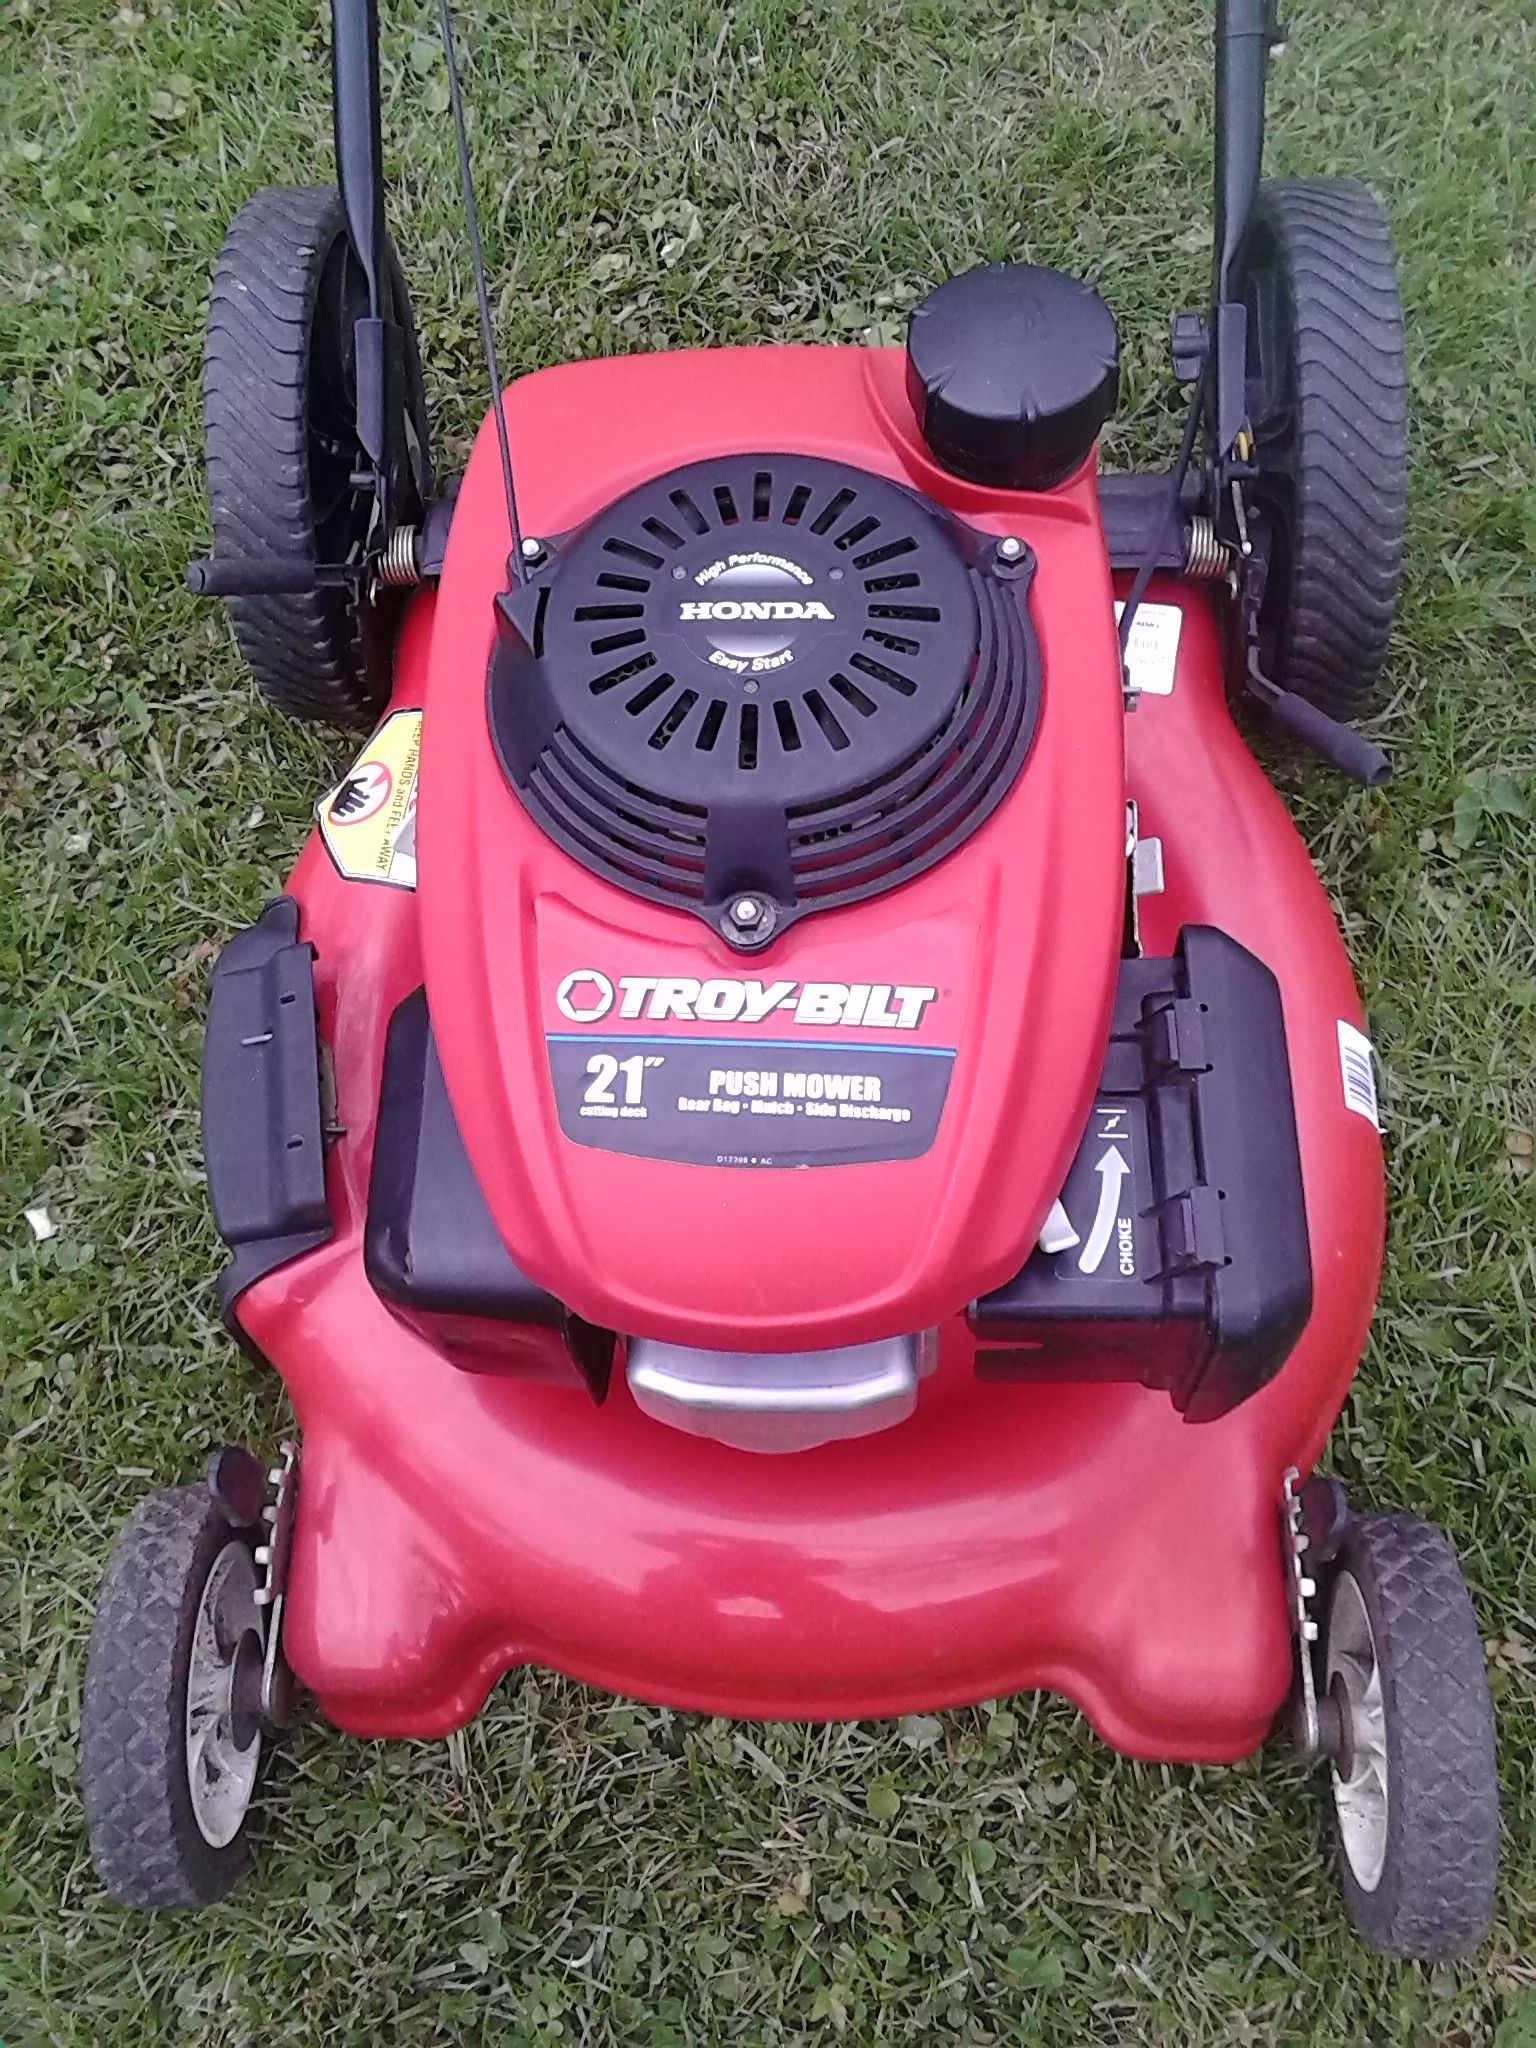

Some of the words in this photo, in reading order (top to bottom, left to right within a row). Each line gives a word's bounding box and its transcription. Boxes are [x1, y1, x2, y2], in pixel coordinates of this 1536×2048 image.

[694, 561, 727, 586] High
[728, 552, 814, 585] Performance
[679, 601, 835, 620] HONDA
[708, 650, 749, 674] Easy
[751, 649, 794, 672] Start
[399, 748, 419, 786] HANDS
[392, 788, 405, 808] and
[617, 975, 937, 1031] TROY-BILT
[709, 1069, 778, 1097] PUSH
[783, 1072, 881, 1102] MOWER
[678, 1097, 711, 1112] Rear
[712, 1098, 741, 1114] Bag
[750, 1099, 795, 1115] Mulch
[805, 1101, 837, 1117] Side
[839, 1103, 911, 1122] Discharge
[1117, 1217, 1135, 1276] CHOKE
